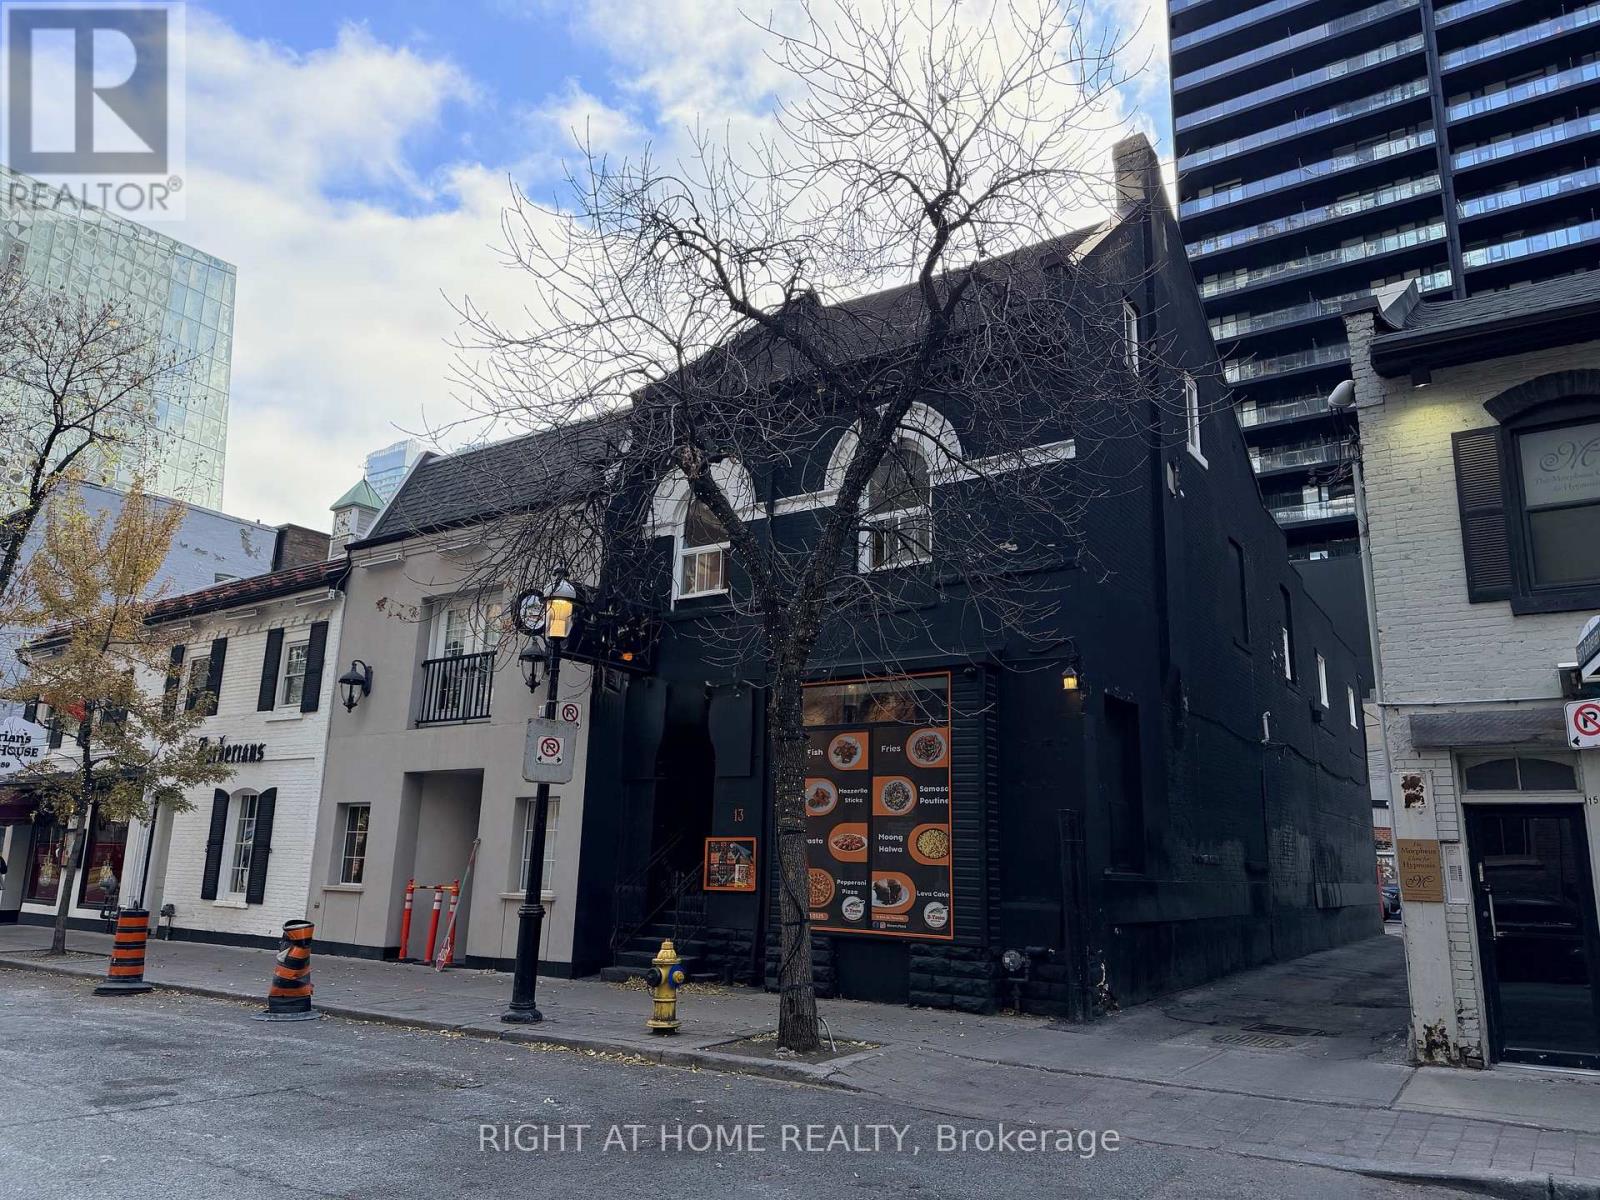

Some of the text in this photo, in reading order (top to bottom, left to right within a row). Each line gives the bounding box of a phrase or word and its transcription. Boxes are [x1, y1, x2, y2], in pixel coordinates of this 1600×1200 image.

[881, 745, 901, 753] Fries
[734, 808, 744, 822] 13
[878, 833, 904, 842] Moong
[836, 879, 867, 887] Pepperoni
